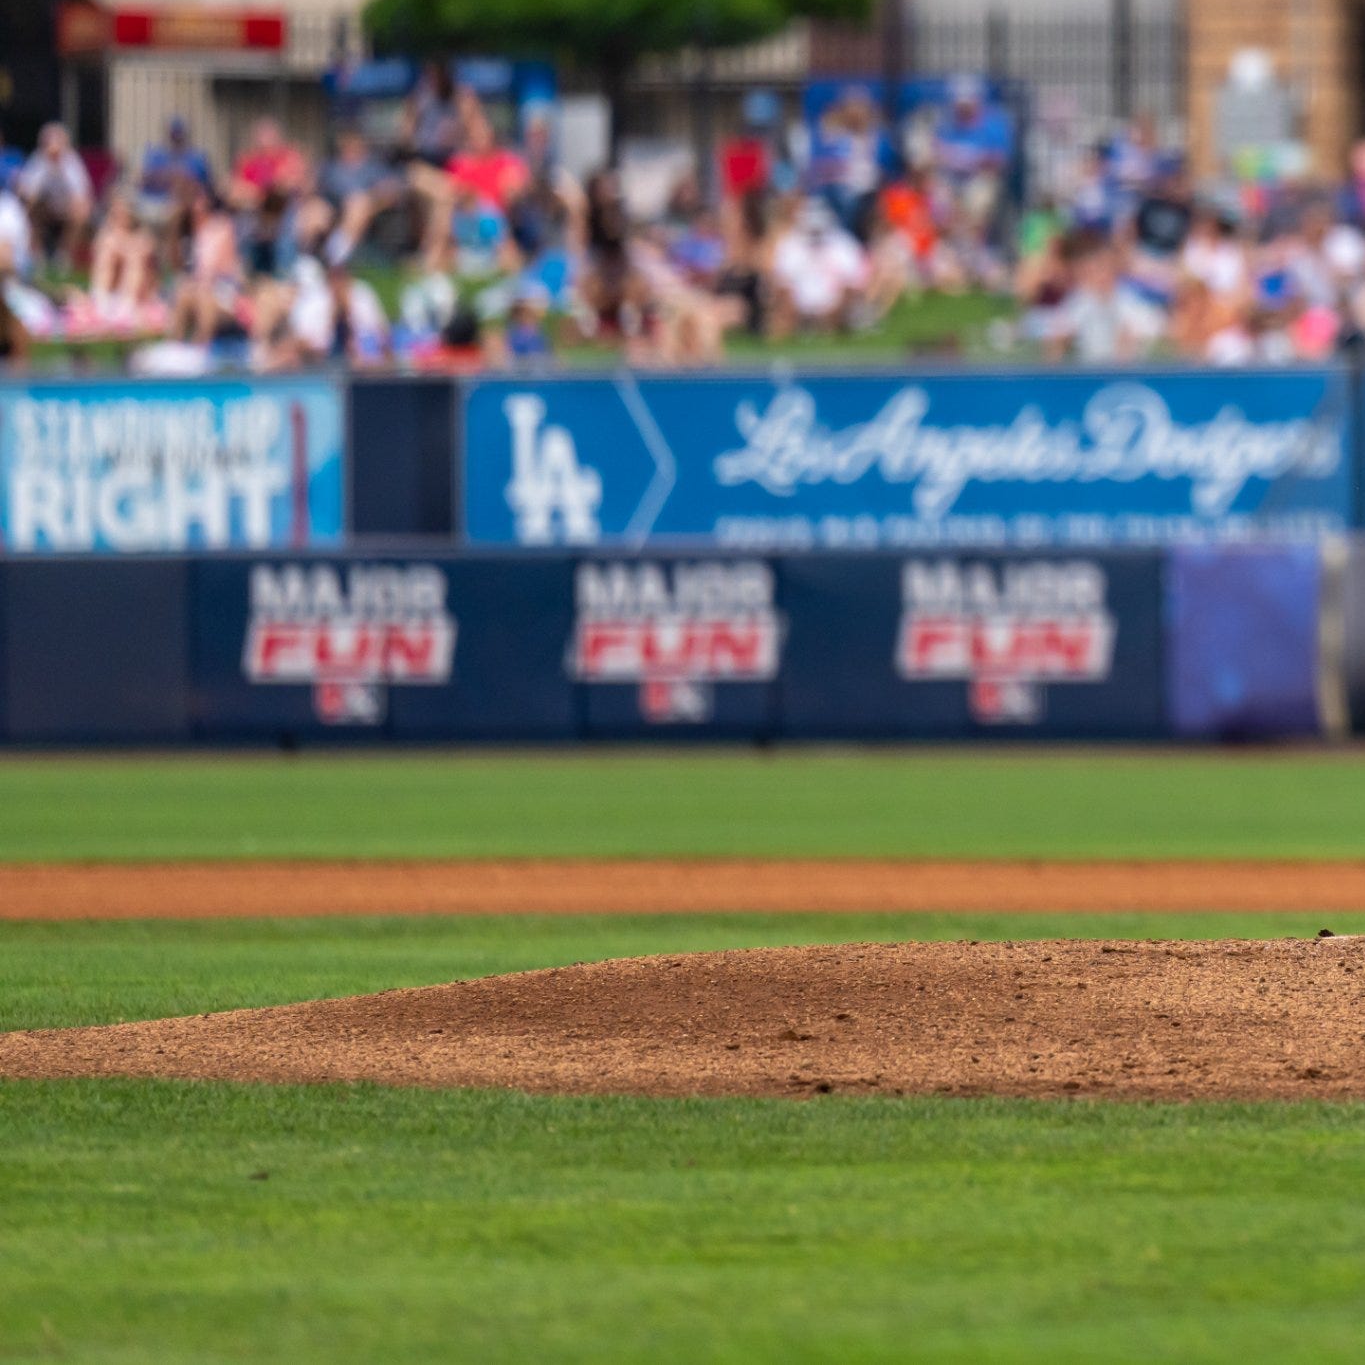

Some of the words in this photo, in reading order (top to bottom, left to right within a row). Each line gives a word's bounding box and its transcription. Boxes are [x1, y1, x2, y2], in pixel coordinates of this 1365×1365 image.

[502, 393, 603, 546] LA
[714, 386, 836, 496] Los
[828, 386, 1092, 519] Angeles
[1084, 381, 1342, 518] Dodgers
[10, 469, 290, 548] RIGHT
[252, 562, 448, 617] MAJOR
[577, 562, 775, 617] MAJOR
[903, 562, 1107, 617] MAJOR
[248, 618, 452, 681] FUN
[573, 618, 778, 681] FUN
[899, 618, 1110, 681] FUN
